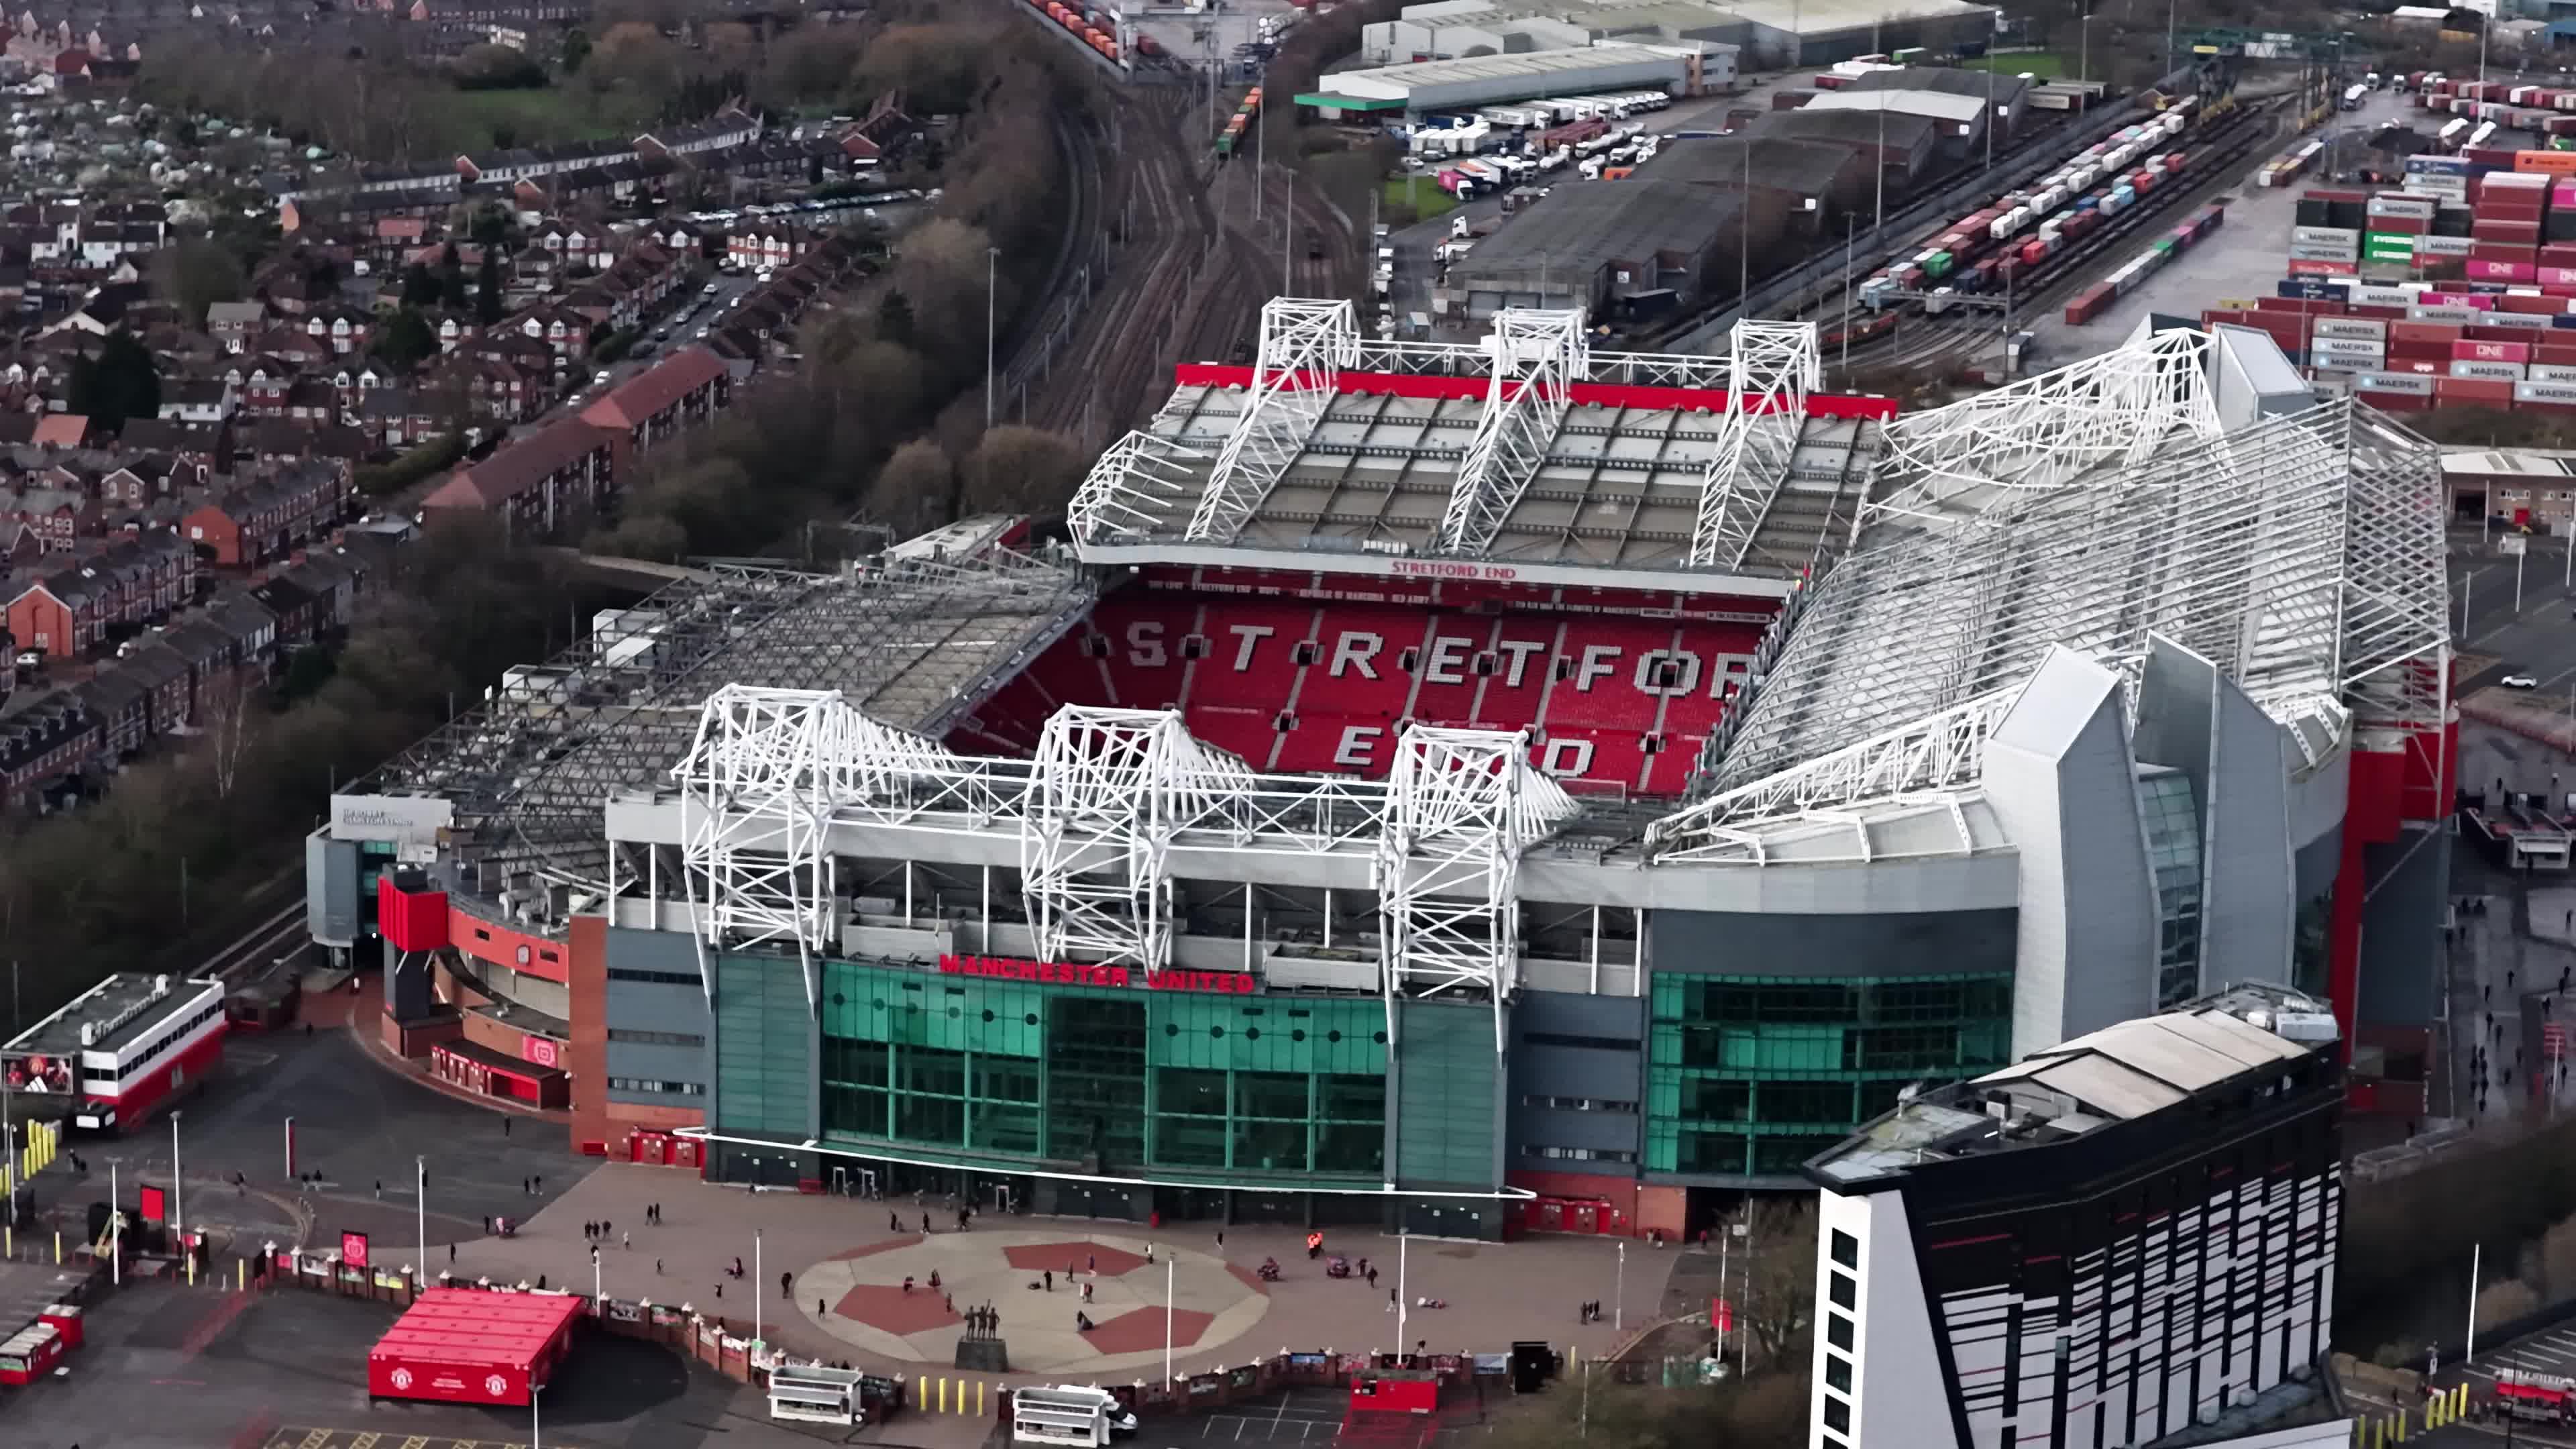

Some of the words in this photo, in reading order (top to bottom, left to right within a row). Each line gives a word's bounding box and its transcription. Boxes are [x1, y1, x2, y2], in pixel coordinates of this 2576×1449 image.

[2385, 204, 2422, 214] MAERSK
[2308, 232, 2348, 242] MAERSK
[2488, 262, 2514, 274] ONE
[2367, 293, 2408, 303] MAERSK
[2426, 311, 2468, 321] MAERSK
[2333, 325, 2375, 335] MAERSK
[2331, 342, 2374, 352] MAERSK
[2476, 344, 2504, 357] ONE
[2330, 358, 2374, 368] MAERSK
[2471, 366, 2516, 377] MAERSK
[2375, 378, 2420, 389] MAERSK
[1391, 561, 1478, 578] STRETFORD
[1485, 567, 1516, 579] END
[940, 953, 1128, 987] MANCHESTER
[1148, 968, 1254, 994] UNITED
